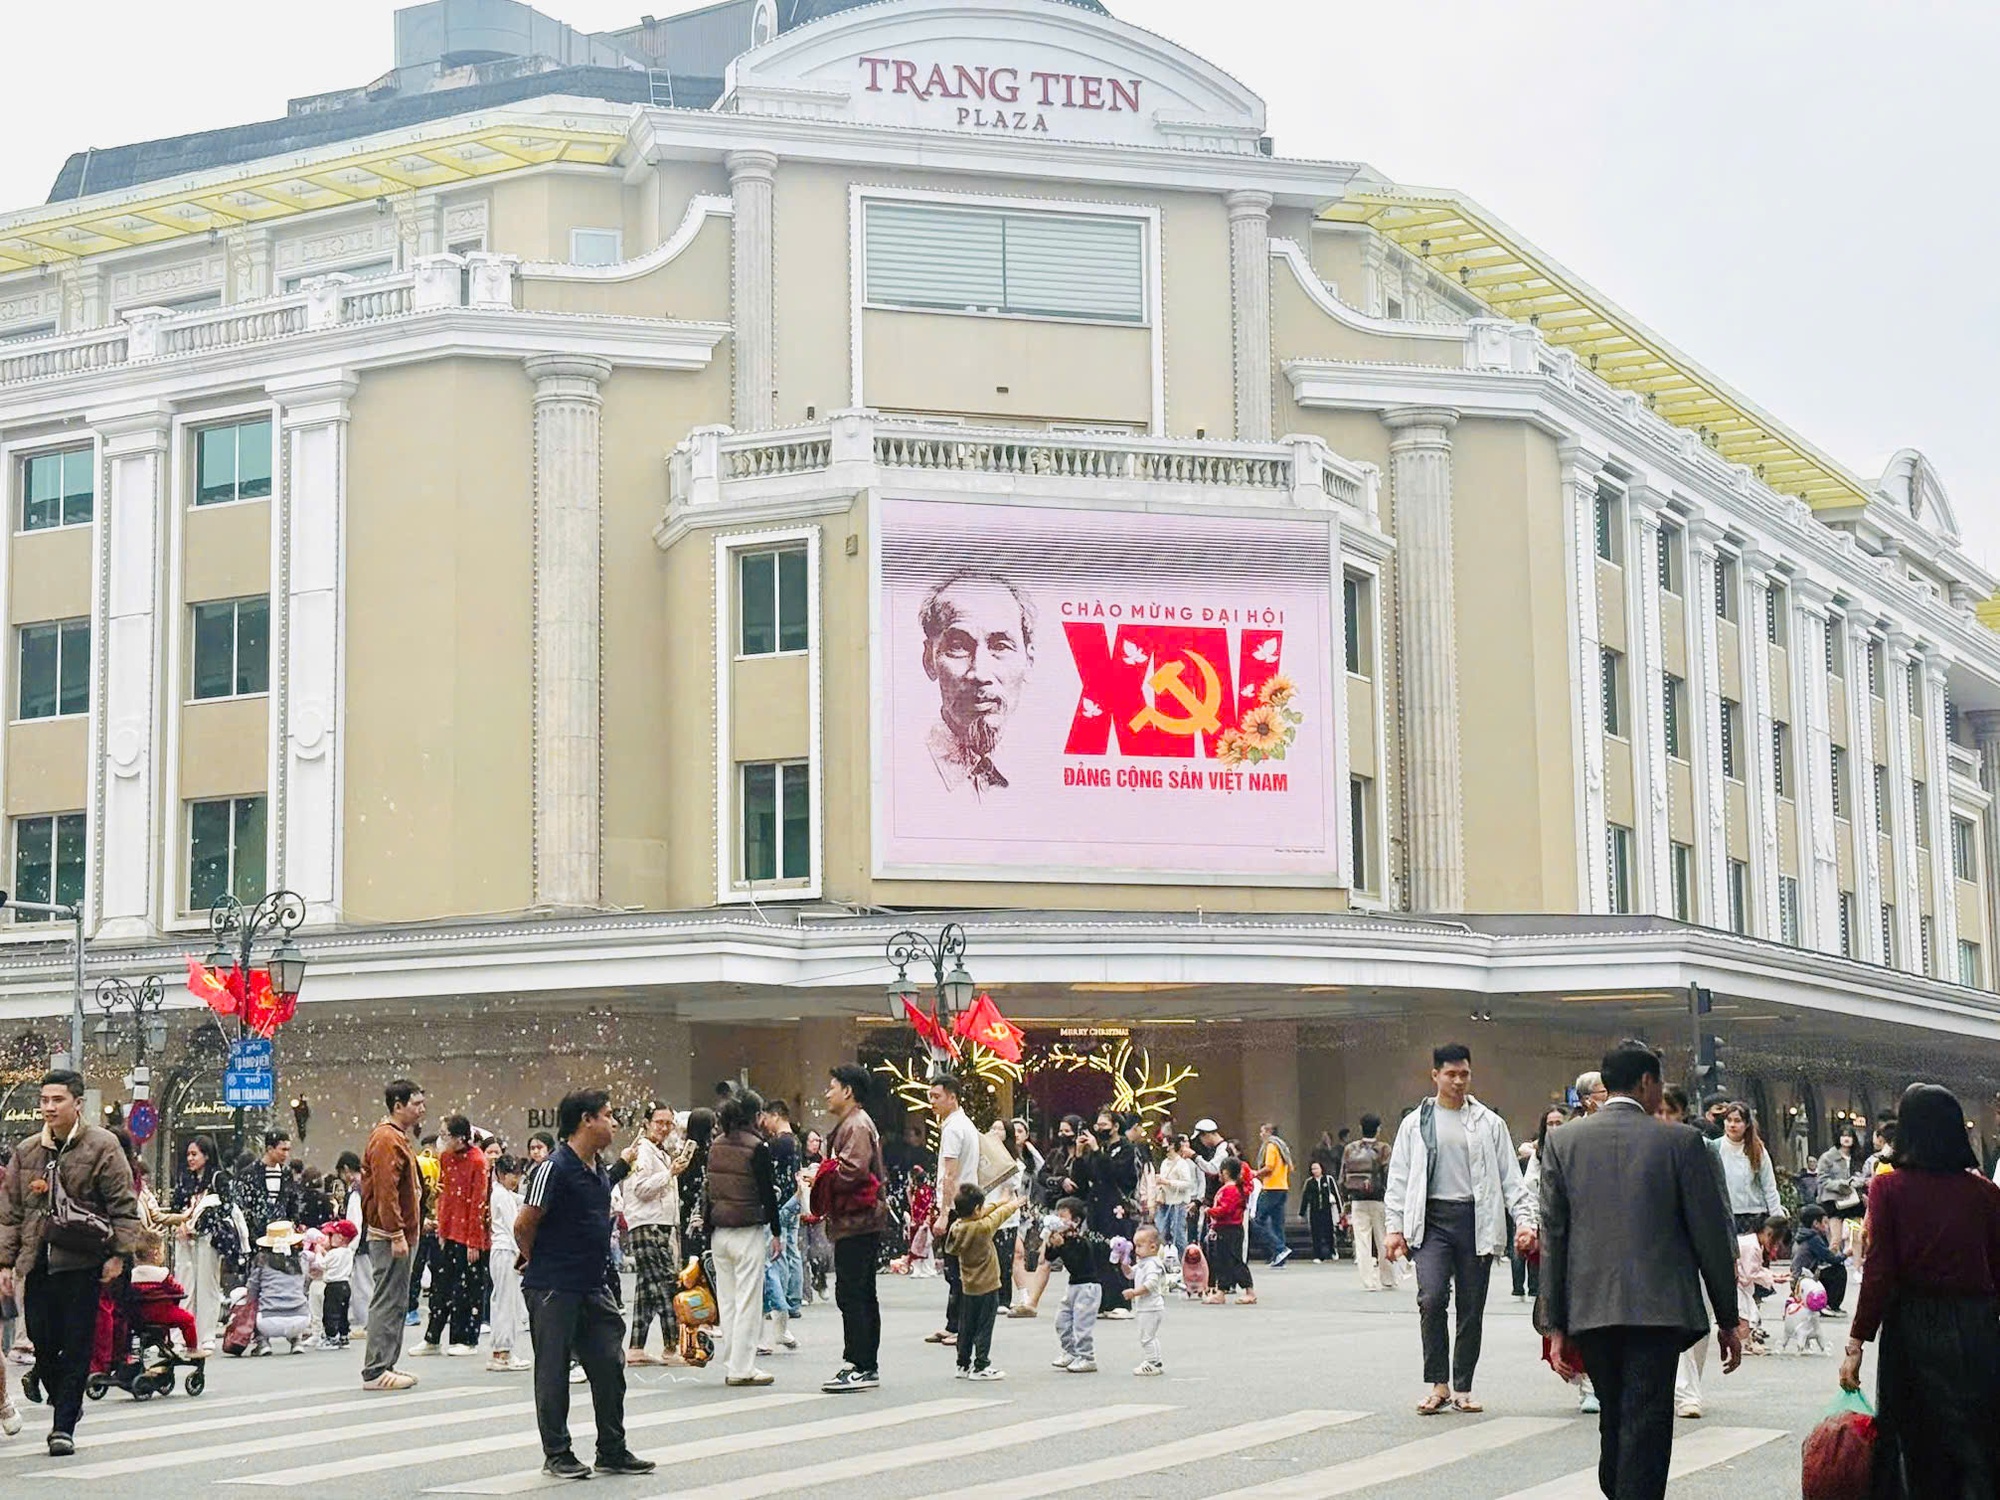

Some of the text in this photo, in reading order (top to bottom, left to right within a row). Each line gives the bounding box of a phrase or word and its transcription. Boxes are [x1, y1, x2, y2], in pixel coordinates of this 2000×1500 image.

[859, 57, 1142, 113] TRANG TIEN
[957, 107, 1049, 132] PLAZA
[1061, 599, 1284, 628] CHÀO MỪNG ĐẠI HỘI
[1063, 761, 1288, 795] ĐẢNG CỘNG SẢN VIỆT NAM
